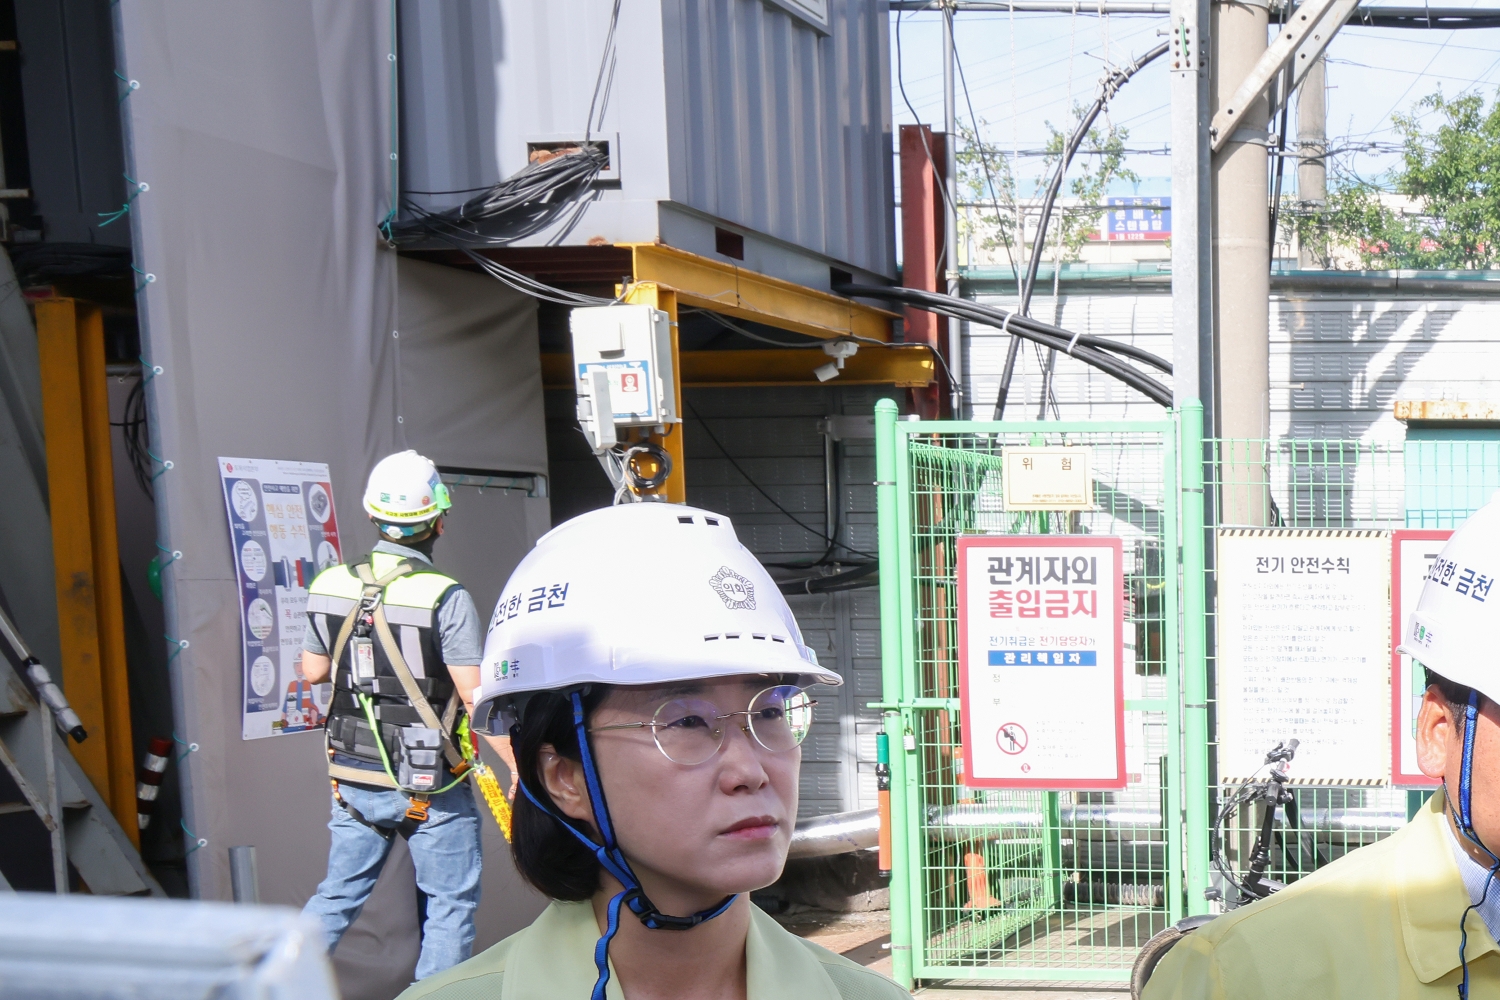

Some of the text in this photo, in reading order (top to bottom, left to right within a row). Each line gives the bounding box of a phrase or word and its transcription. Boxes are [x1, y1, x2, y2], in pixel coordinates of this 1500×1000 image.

[987, 556, 1097, 585] 관계자외
[1255, 556, 1351, 575] 전기 안전수칙
[722, 583, 748, 596] 의회
[1427, 558, 1458, 588] 전한
[1455, 567, 1495, 603] 금천
[527, 582, 570, 614] 금천
[988, 589, 1097, 618] 출입금지
[1003, 652, 1081, 665] 관리책임자
